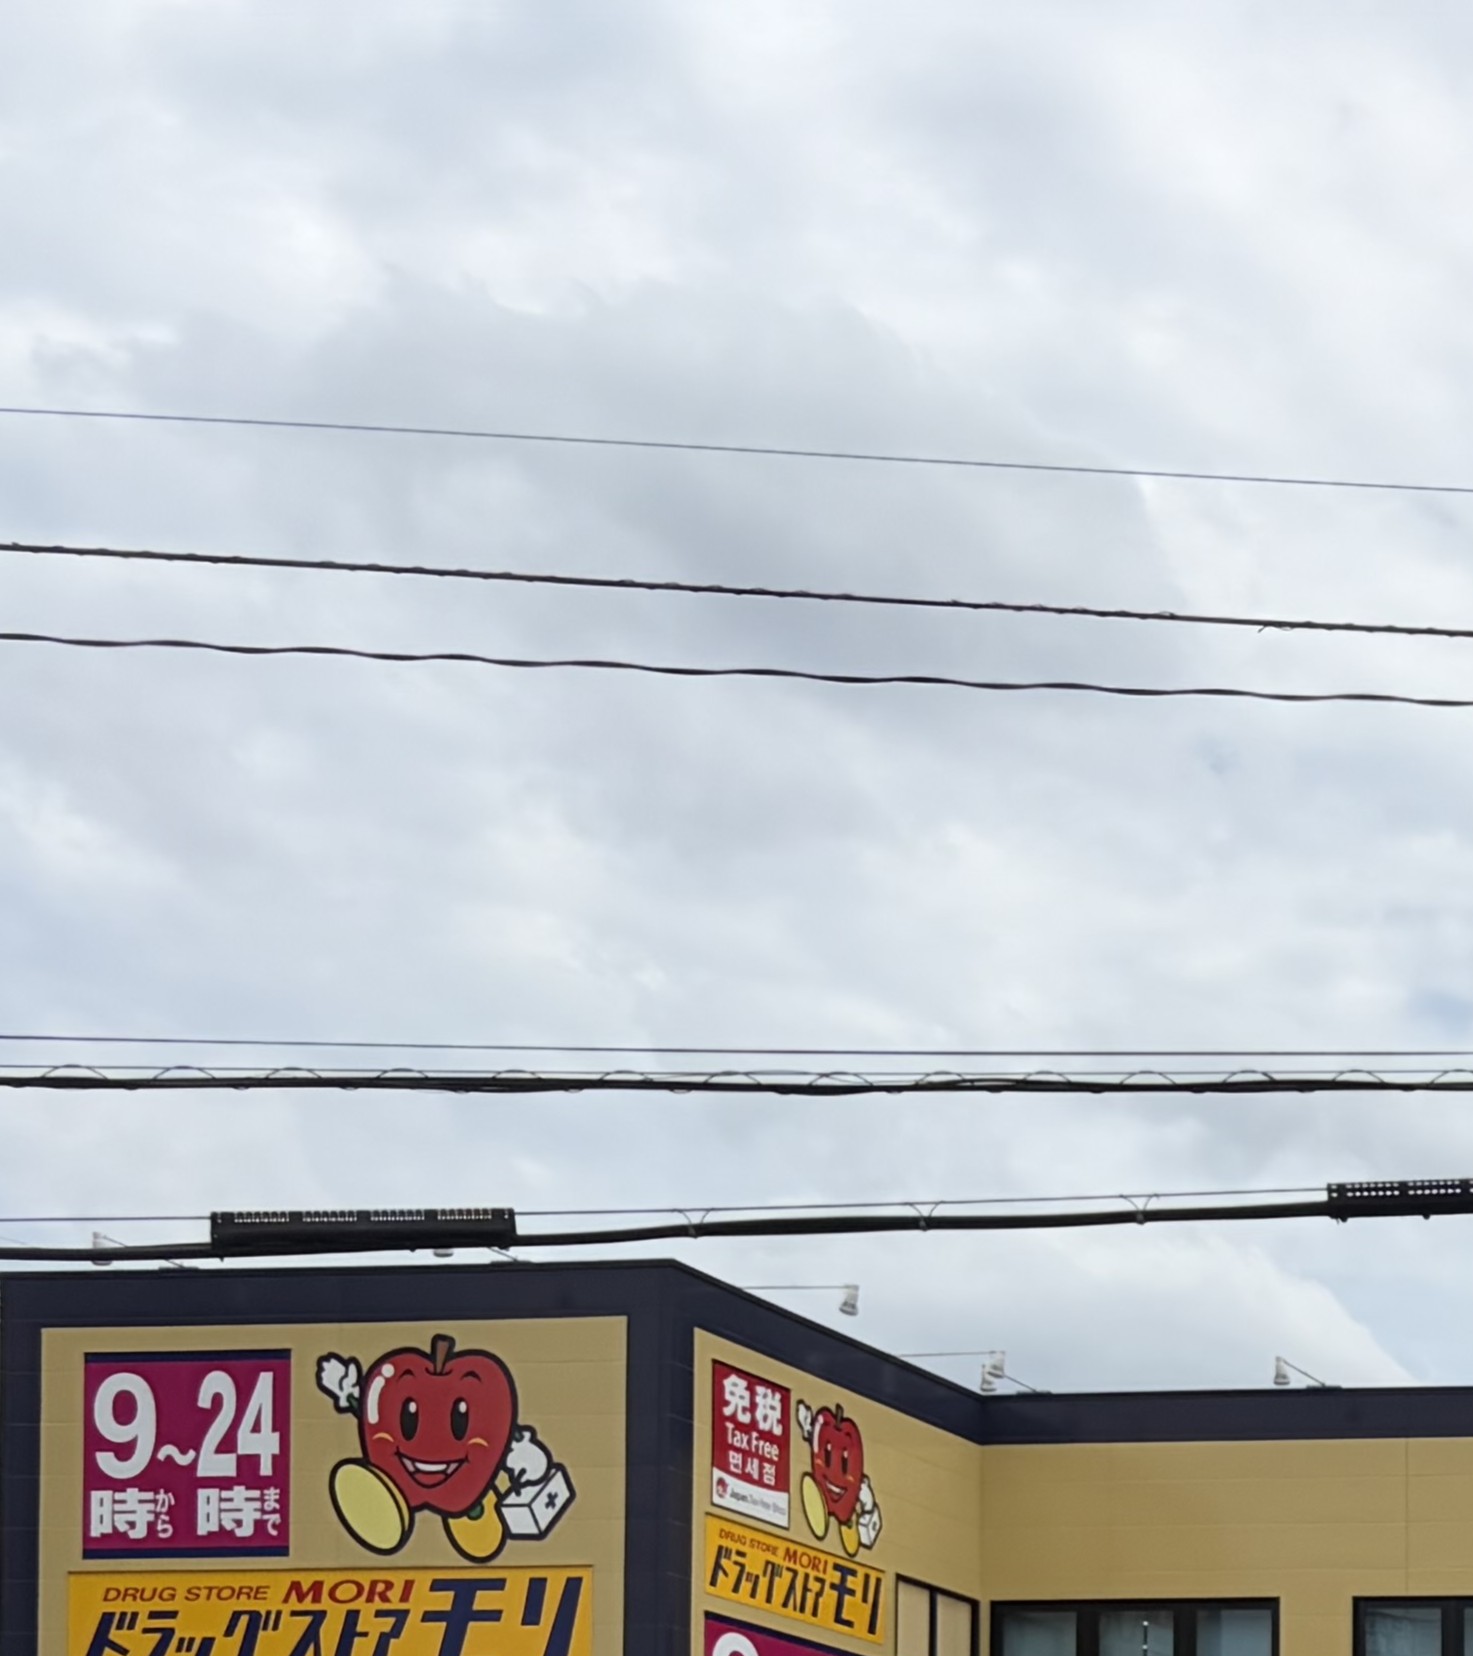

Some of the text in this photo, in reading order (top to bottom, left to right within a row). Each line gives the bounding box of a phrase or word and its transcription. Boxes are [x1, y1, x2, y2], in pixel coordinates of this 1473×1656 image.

[722, 1374, 783, 1436] 免税
[725, 1422, 779, 1461] Tax Free
[783, 1546, 828, 1575] MORI
[103, 1579, 415, 1604] DRUG STORE MORI
